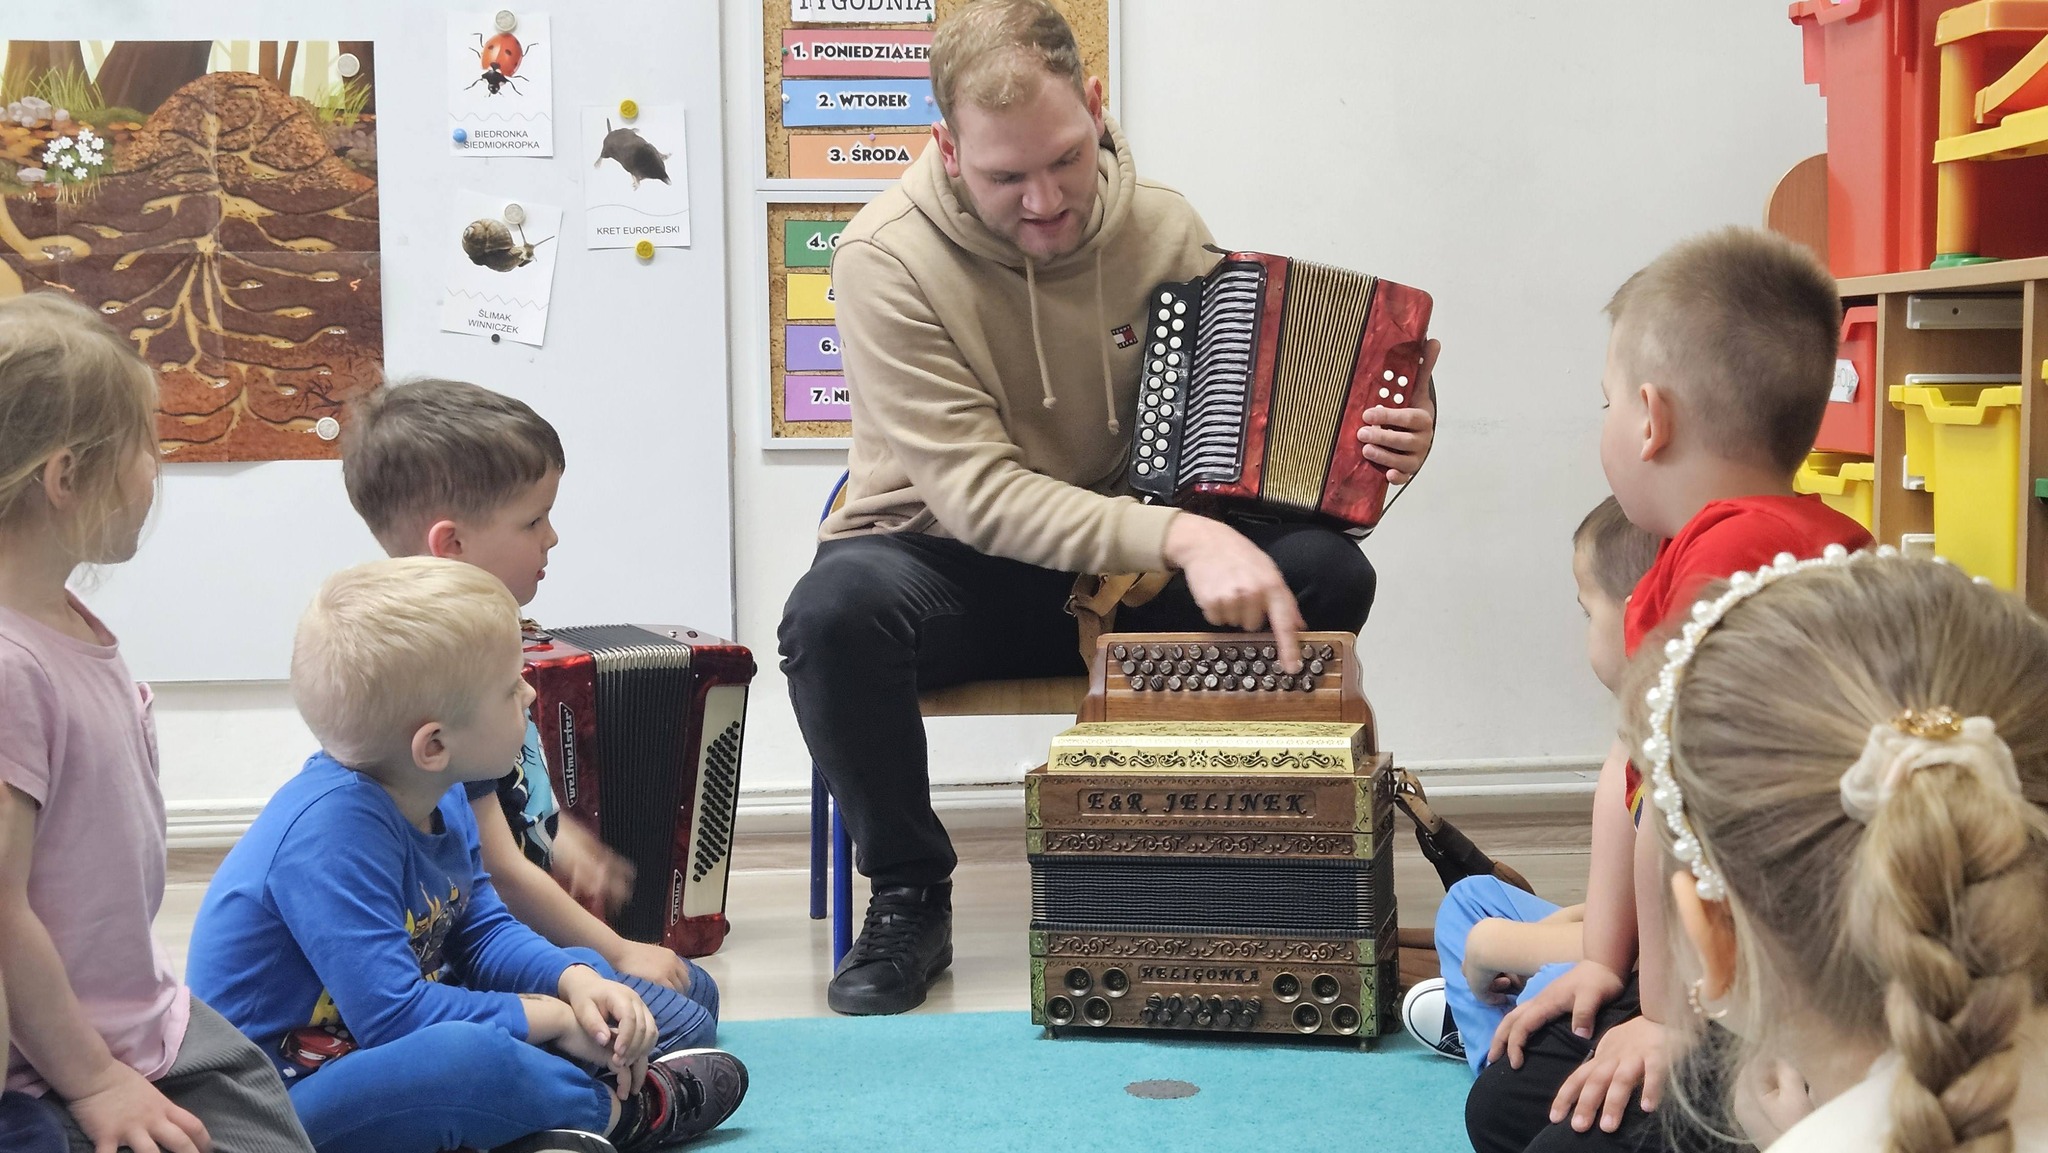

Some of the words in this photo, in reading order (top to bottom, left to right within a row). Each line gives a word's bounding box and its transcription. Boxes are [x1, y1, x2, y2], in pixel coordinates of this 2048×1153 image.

[793, 44, 806, 57] 1.
[818, 95, 833, 107] 2.
[839, 94, 908, 107] WTOREK
[474, 130, 528, 138] BIEDRONKA
[463, 141, 540, 149] SIEDMIOKROPKA
[830, 149, 845, 161] 3.
[852, 144, 909, 161] ŚRODA
[596, 227, 620, 235] KRET
[623, 226, 680, 234] EUROPEJSKI
[809, 235, 825, 248] 4.
[478, 309, 511, 321] ŚLIMAK
[468, 319, 519, 334] WINNICZEK
[821, 339, 837, 352] 6.
[813, 390, 829, 402] 7.
[1162, 792, 1308, 815] JELINEK
[1141, 965, 1260, 983] HELIGONKA
